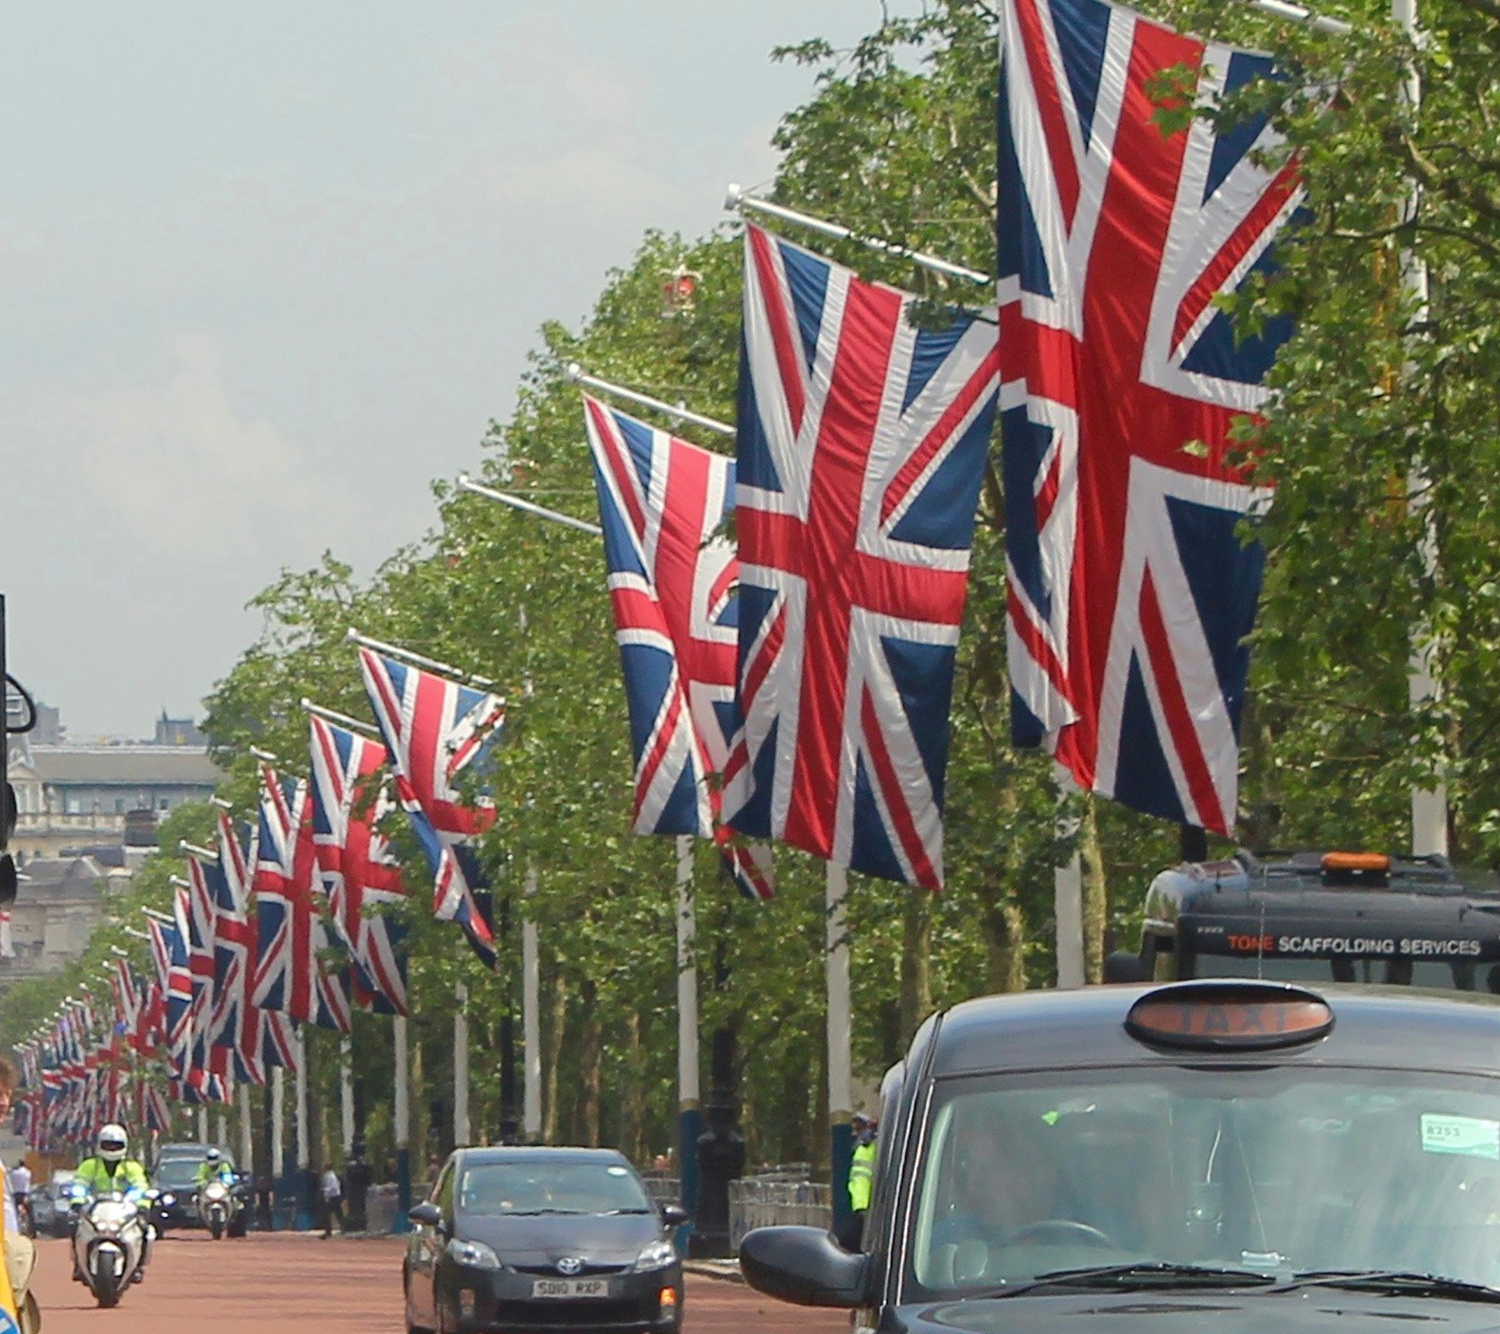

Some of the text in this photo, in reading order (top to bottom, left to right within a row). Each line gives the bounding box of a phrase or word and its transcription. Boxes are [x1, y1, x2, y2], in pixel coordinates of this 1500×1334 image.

[1278, 936, 1395, 954] SCAFFOLDING
[1400, 937, 1482, 956] SERVICES
[1178, 1003, 1288, 1034] TAXI
